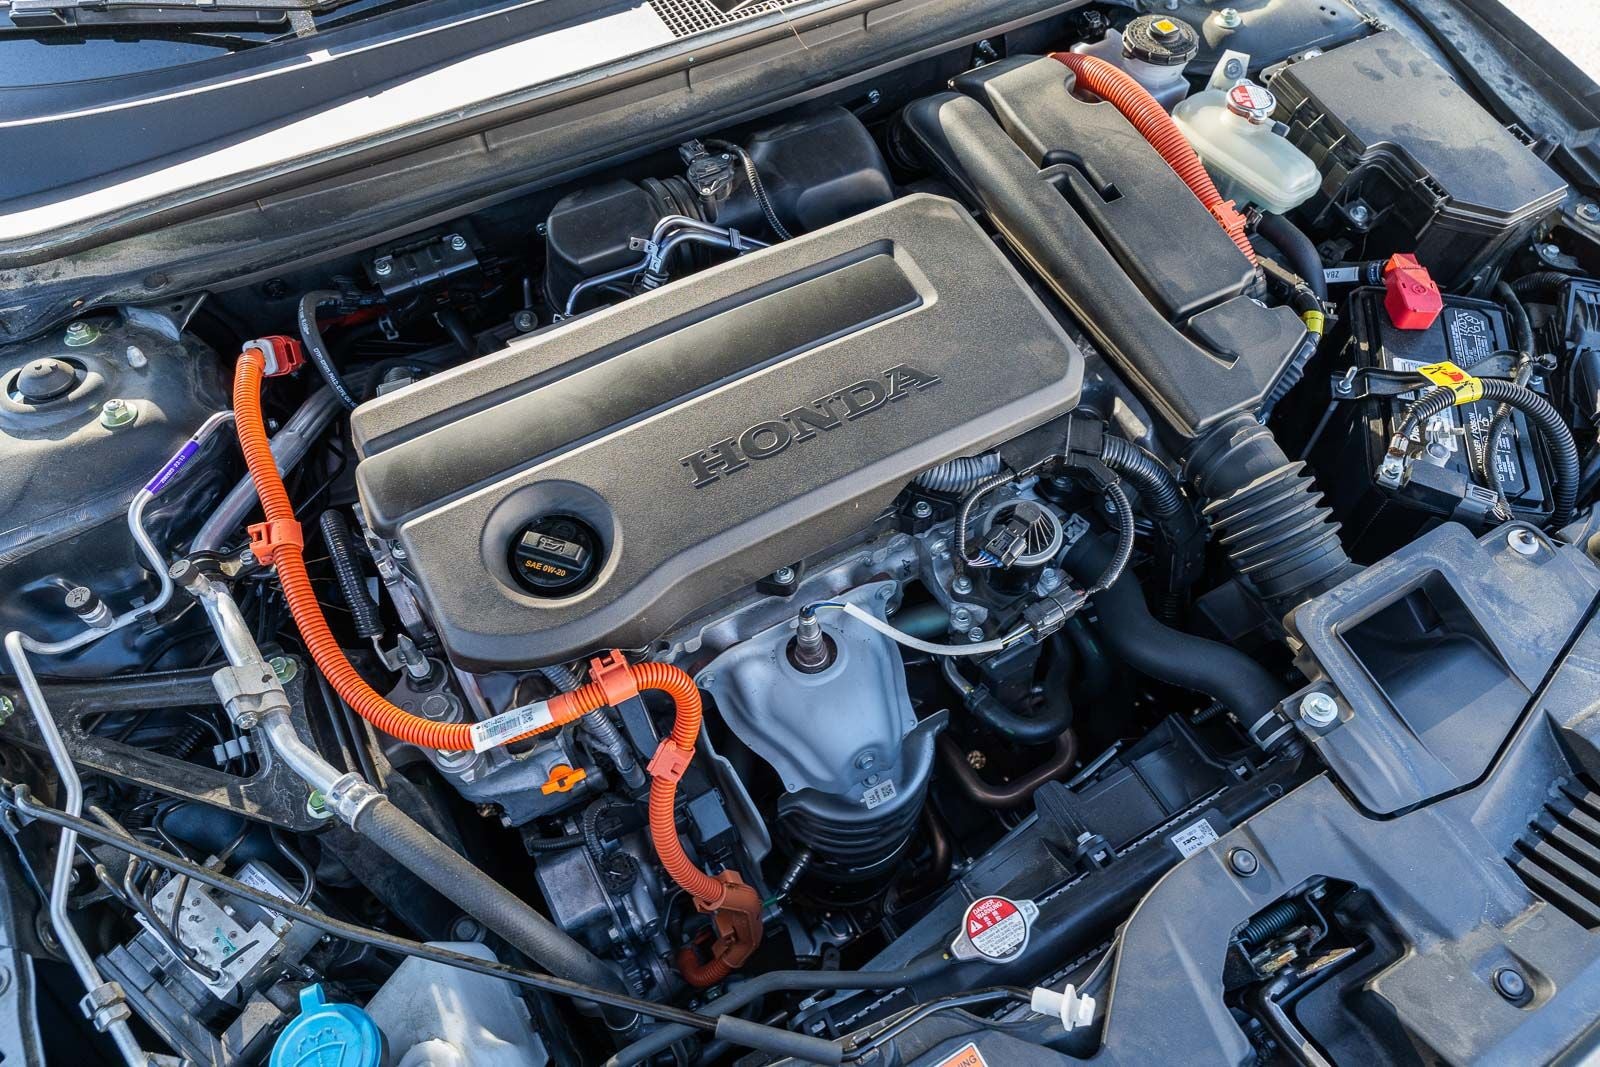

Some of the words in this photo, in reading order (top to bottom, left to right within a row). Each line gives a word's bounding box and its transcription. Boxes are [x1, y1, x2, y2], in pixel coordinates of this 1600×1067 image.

[678, 363, 941, 489] HONDA
[525, 560, 542, 570] SAE
[542, 563, 566, 577] 0W-20
[972, 899, 994, 915] DANGER
[977, 901, 1003, 920] WARNING
